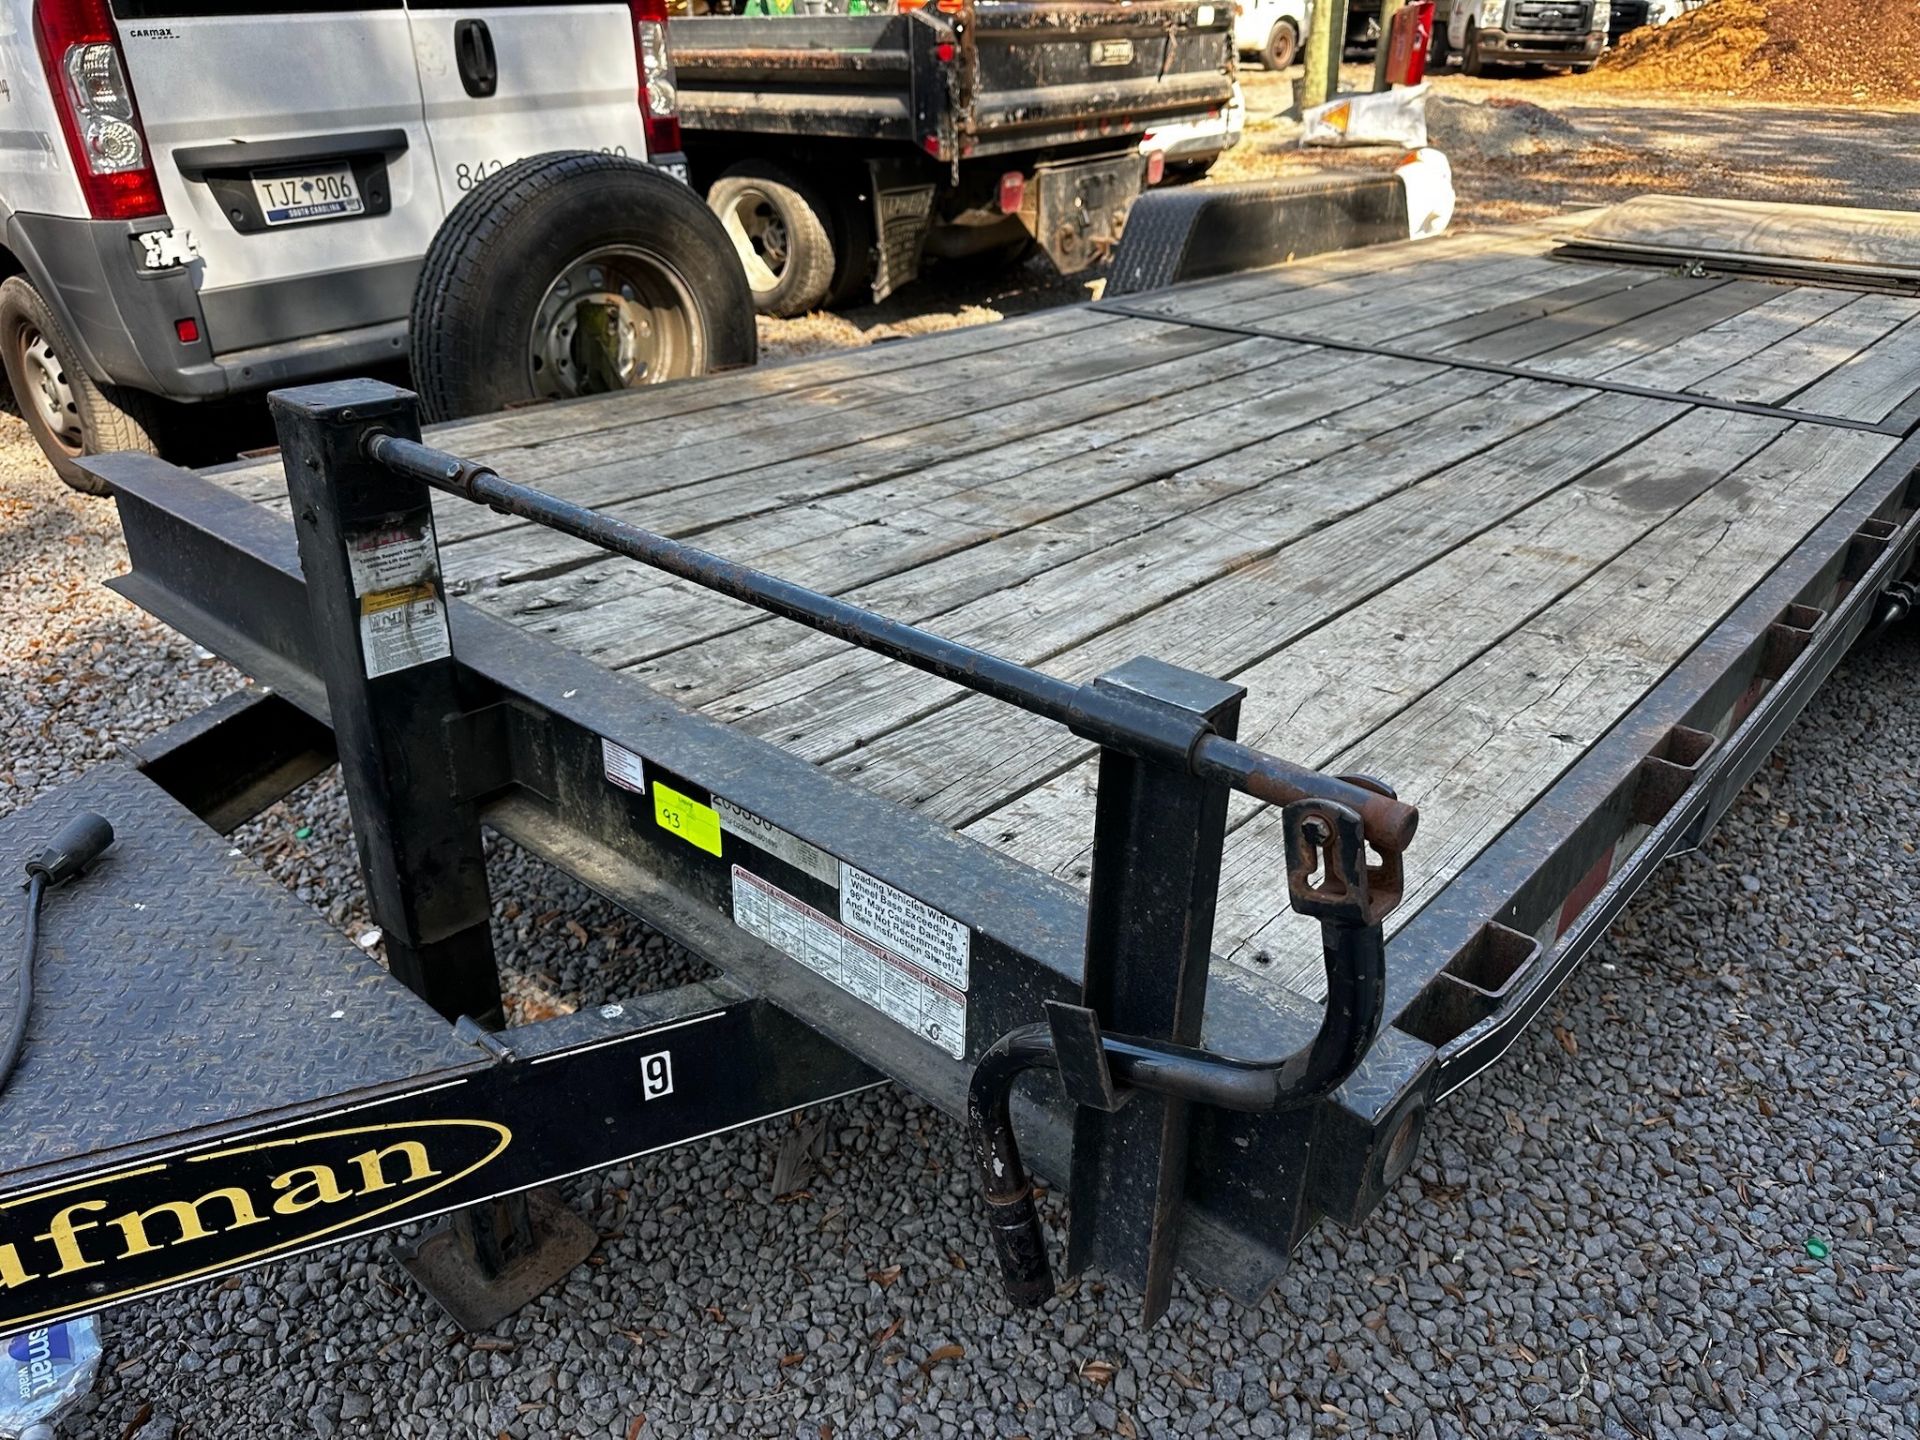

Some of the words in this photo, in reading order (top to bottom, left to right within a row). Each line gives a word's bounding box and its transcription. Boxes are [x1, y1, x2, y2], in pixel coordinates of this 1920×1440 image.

[262, 181, 302, 208] TJZ
[315, 175, 352, 201] 906
[288, 208, 309, 218] SOUTH
[310, 203, 341, 216] CAROLINA
[663, 808, 680, 829] 93
[849, 867, 885, 894] Loading
[886, 887, 925, 914] Vehicles
[927, 908, 949, 927] With
[951, 922, 959, 932] A
[850, 878, 878, 900] Wheel
[880, 894, 903, 913] Base
[905, 908, 954, 941] Exceeding
[845, 897, 863, 911] And
[864, 905, 873, 918] Is
[875, 913, 891, 929] Not
[893, 923, 963, 966] Recommended
[867, 898, 886, 916] May
[887, 909, 916, 931] Cause
[918, 924, 958, 953] Damage
[873, 921, 922, 954] Instruction
[646, 1055, 669, 1095] 9
[28, 1327, 58, 1396] smart
[18, 1366, 31, 1400] water
